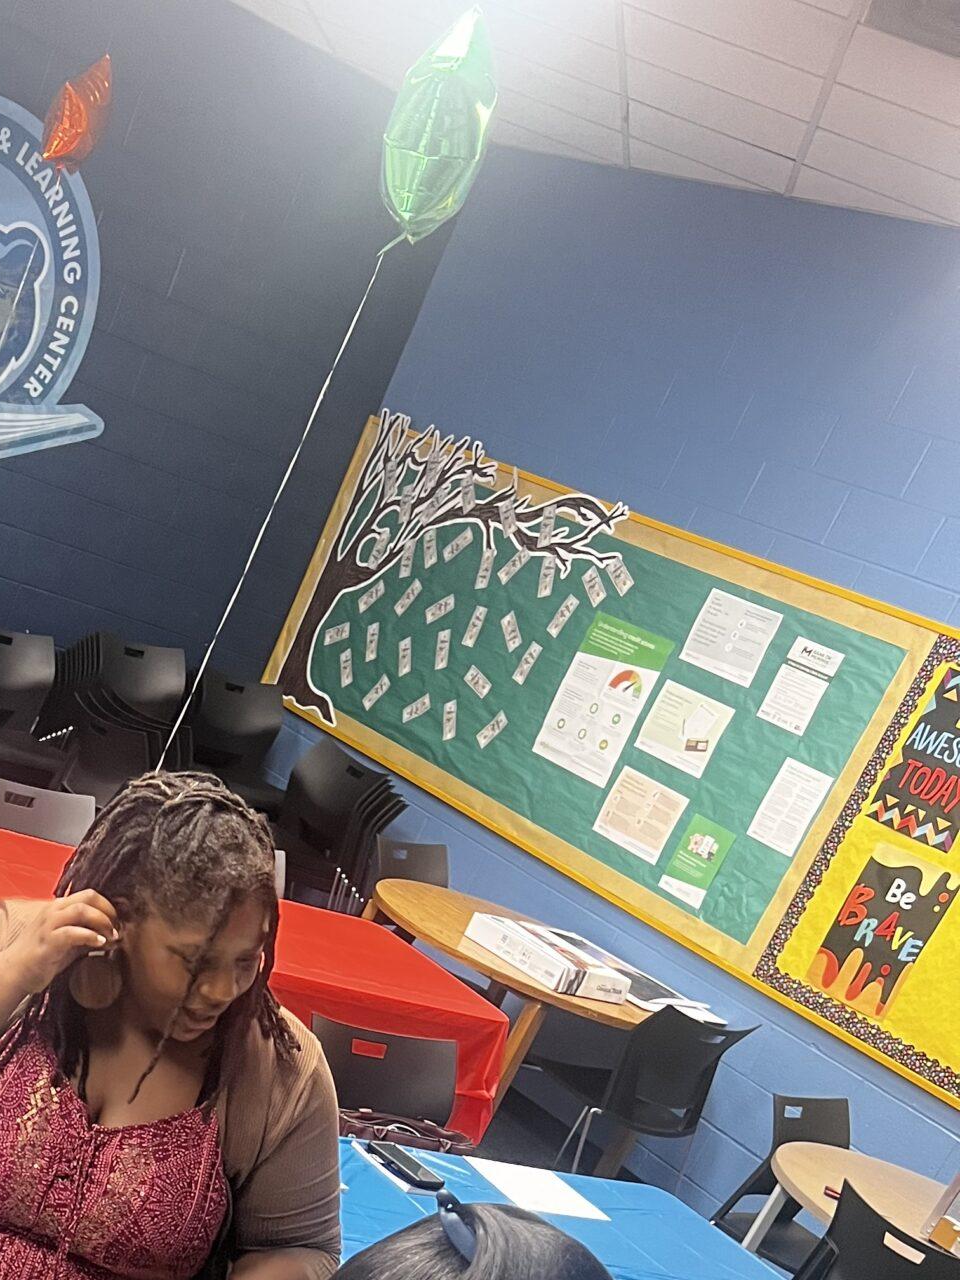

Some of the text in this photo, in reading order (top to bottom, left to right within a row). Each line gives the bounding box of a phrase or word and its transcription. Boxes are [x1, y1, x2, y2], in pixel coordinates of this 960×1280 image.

[15, 140, 82, 284] LEARNING
[23, 295, 80, 399] CENTER
[905, 721, 960, 770] AWES
[898, 758, 960, 815] TODAY
[837, 883, 924, 963] BRAVE
[885, 877, 917, 911] Be
